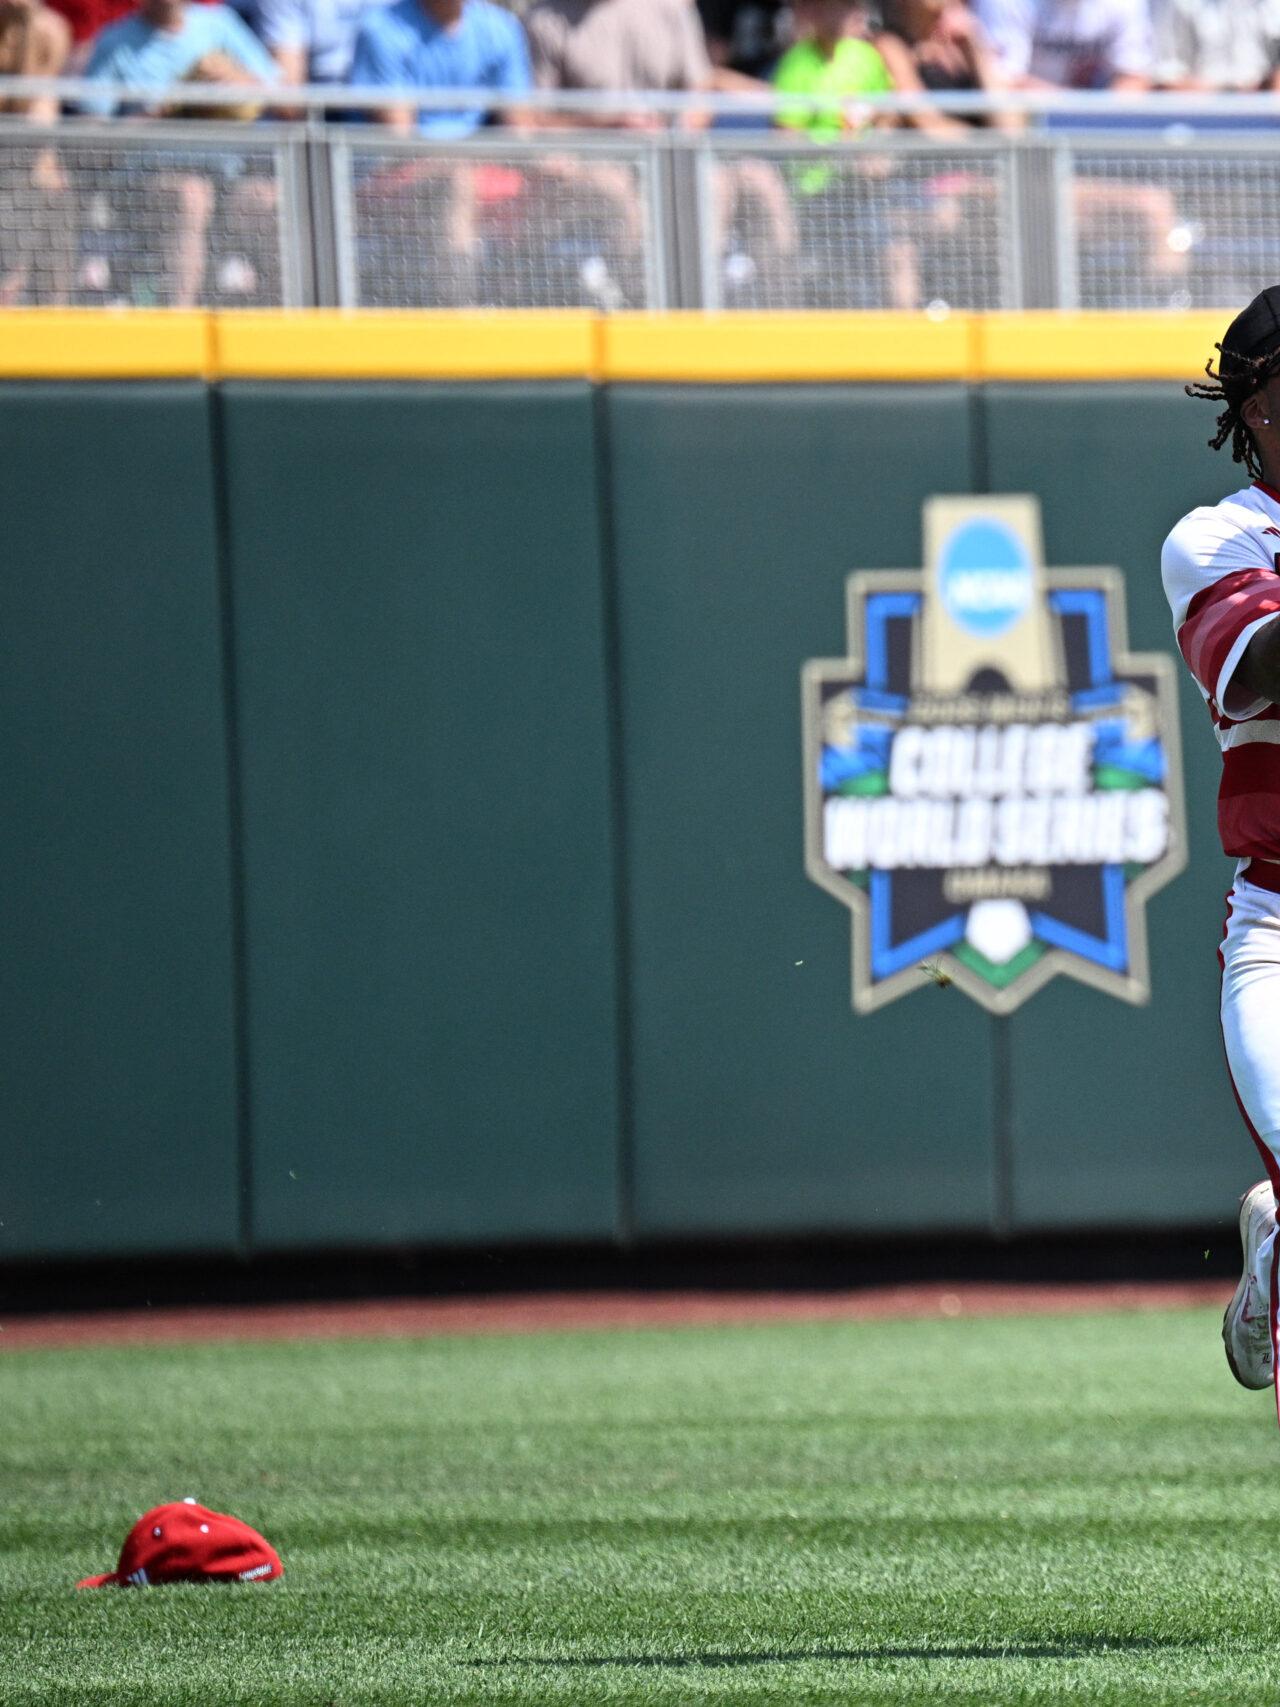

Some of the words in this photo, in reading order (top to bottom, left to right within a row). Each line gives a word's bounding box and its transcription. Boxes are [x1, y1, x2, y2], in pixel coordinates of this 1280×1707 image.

[889, 723, 1094, 797] COLLEGE
[824, 797, 991, 869] WORLD
[994, 789, 1169, 866] SERIES
